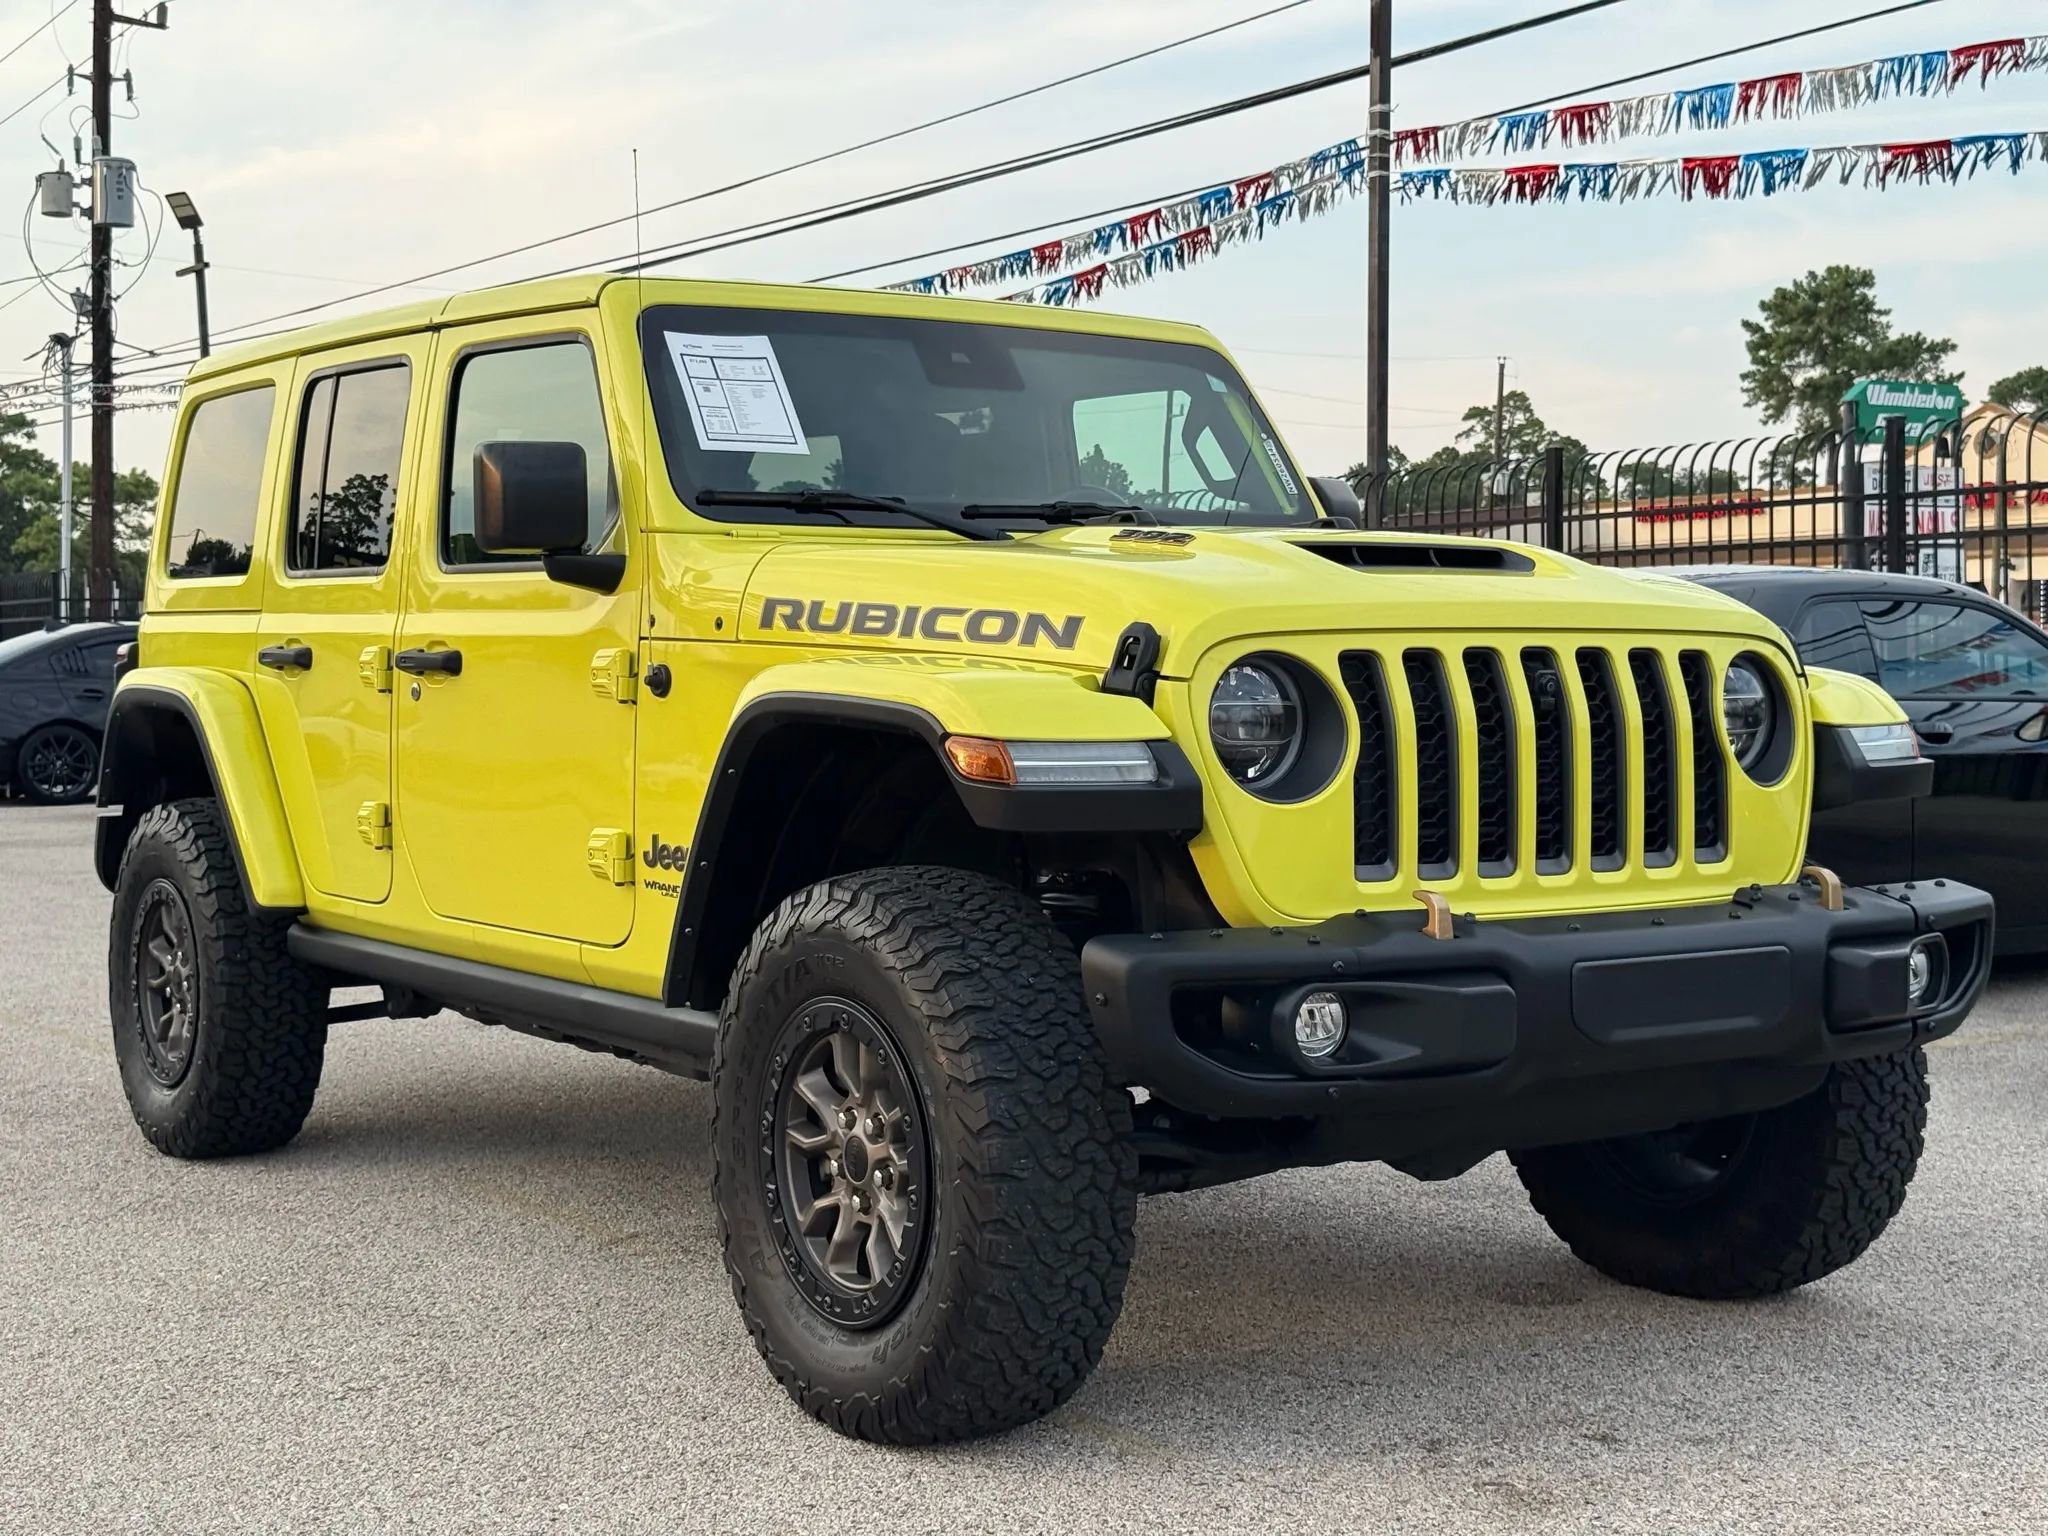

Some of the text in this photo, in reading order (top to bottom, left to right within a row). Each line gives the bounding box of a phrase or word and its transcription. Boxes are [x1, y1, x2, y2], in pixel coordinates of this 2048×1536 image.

[1866, 383, 1956, 410] Wimbledon
[1109, 528, 1197, 547] 392
[758, 596, 1086, 650] RUBICON
